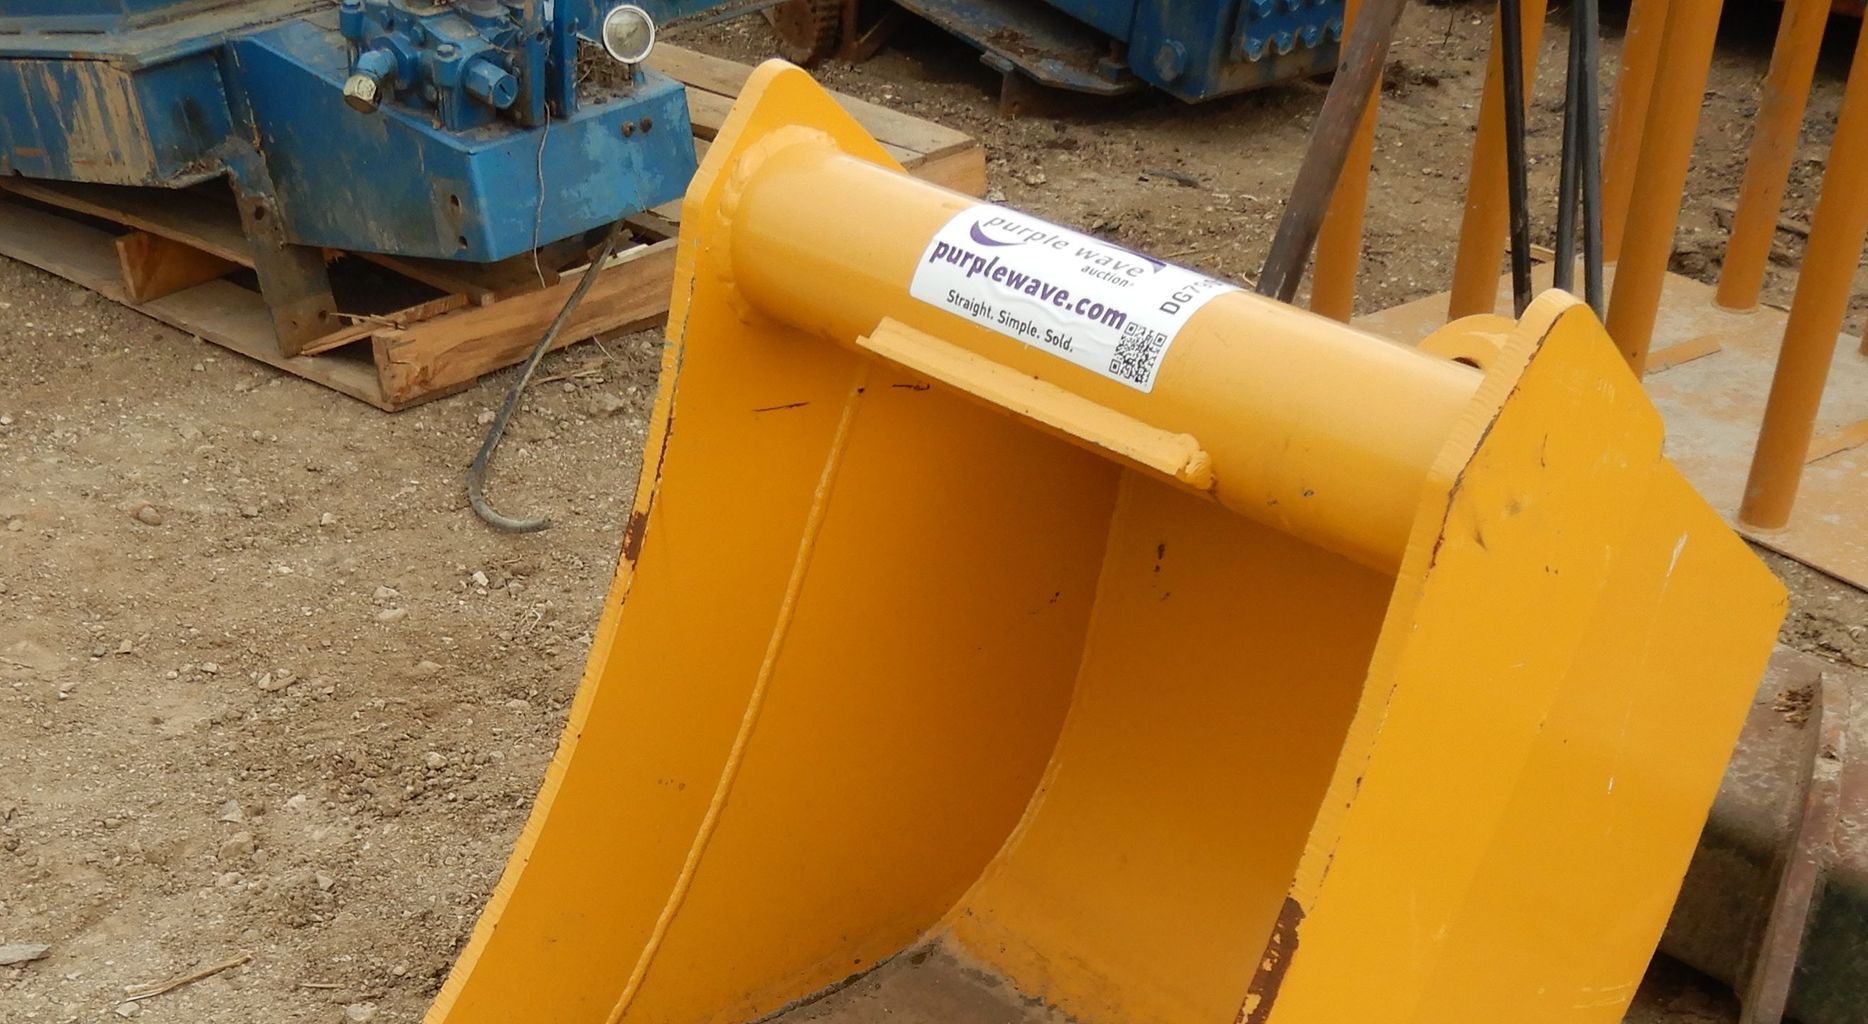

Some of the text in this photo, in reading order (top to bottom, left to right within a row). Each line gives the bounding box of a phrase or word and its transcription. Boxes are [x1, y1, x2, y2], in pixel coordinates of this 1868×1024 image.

[983, 216, 1144, 278] purple wave
[1081, 264, 1132, 288] auction
[929, 241, 1127, 330] purplewave.com
[947, 289, 1074, 353] Straight. Simple. Sold.
